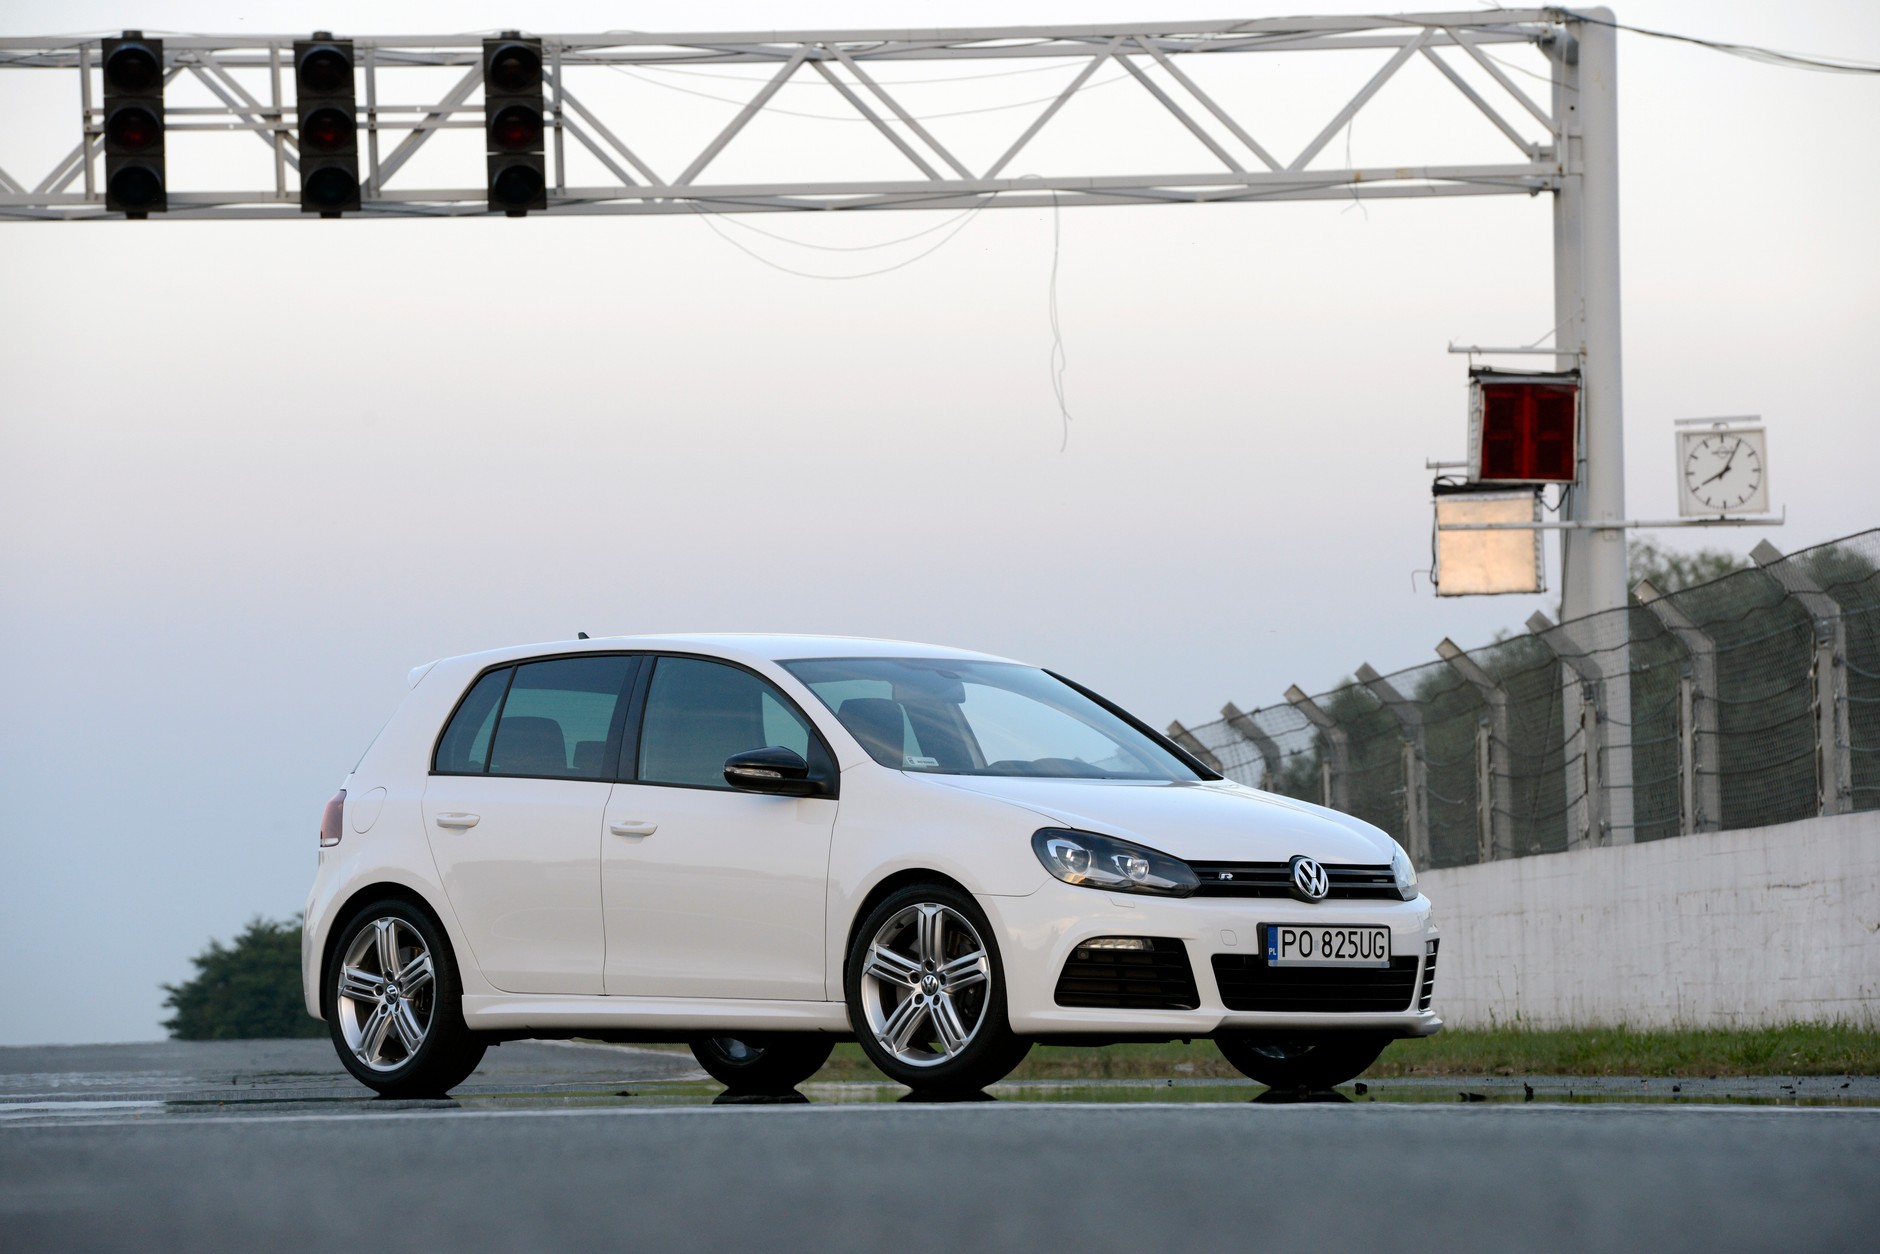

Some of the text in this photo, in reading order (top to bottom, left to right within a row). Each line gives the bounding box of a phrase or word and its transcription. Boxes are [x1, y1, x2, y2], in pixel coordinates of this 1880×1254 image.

[1219, 872, 1234, 881] R
[1282, 930, 1385, 959] PO 825UG
[1268, 947, 1277, 956] PL
